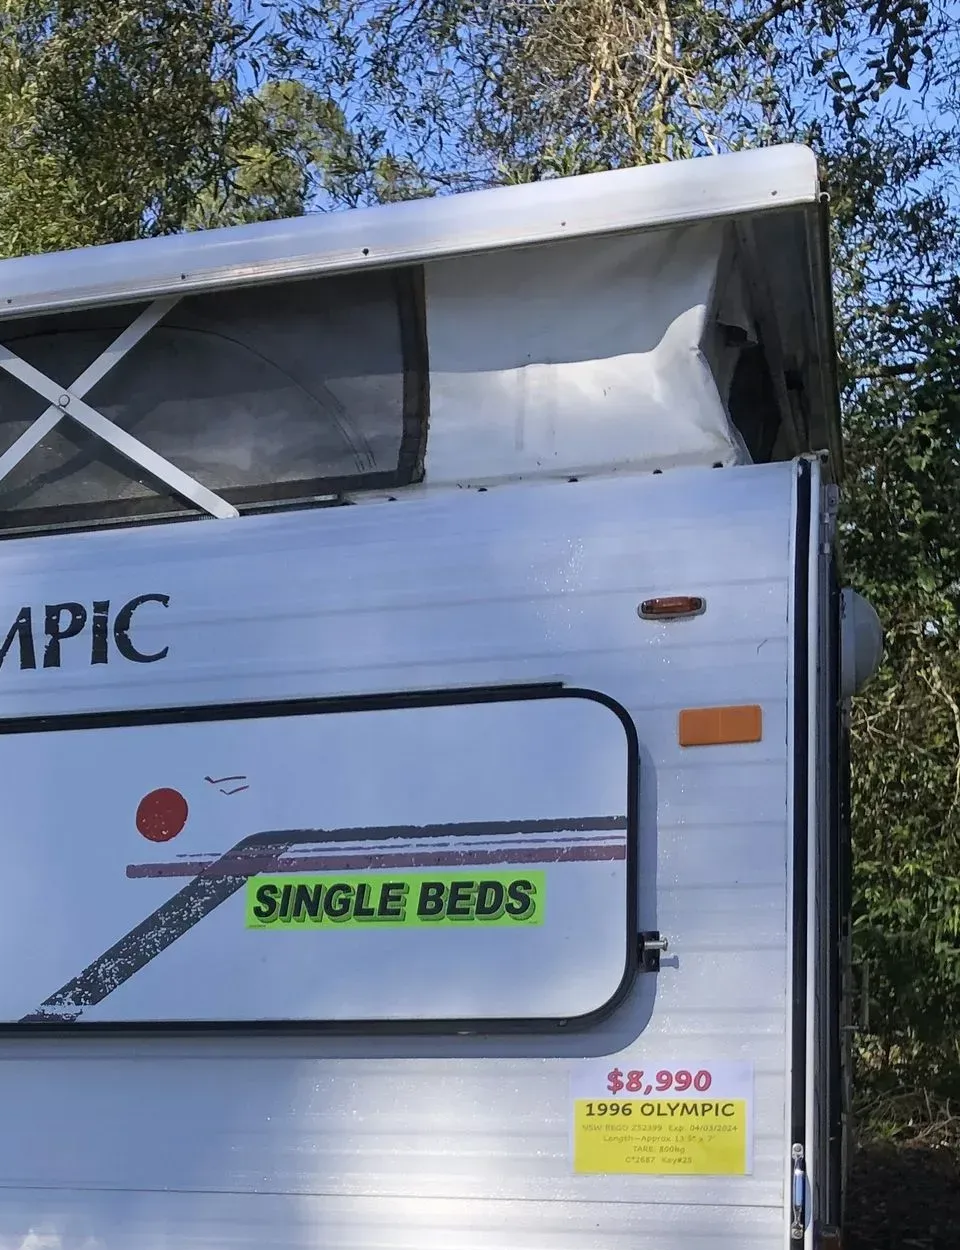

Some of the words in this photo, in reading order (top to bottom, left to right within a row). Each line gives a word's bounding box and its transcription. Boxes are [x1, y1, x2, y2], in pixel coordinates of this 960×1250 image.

[252, 882, 409, 923] SINGLE
[416, 879, 537, 921] BEDS
[606, 1067, 713, 1095] $8,990
[585, 1102, 633, 1117] 1996
[640, 1102, 736, 1117] OLYMPIC
